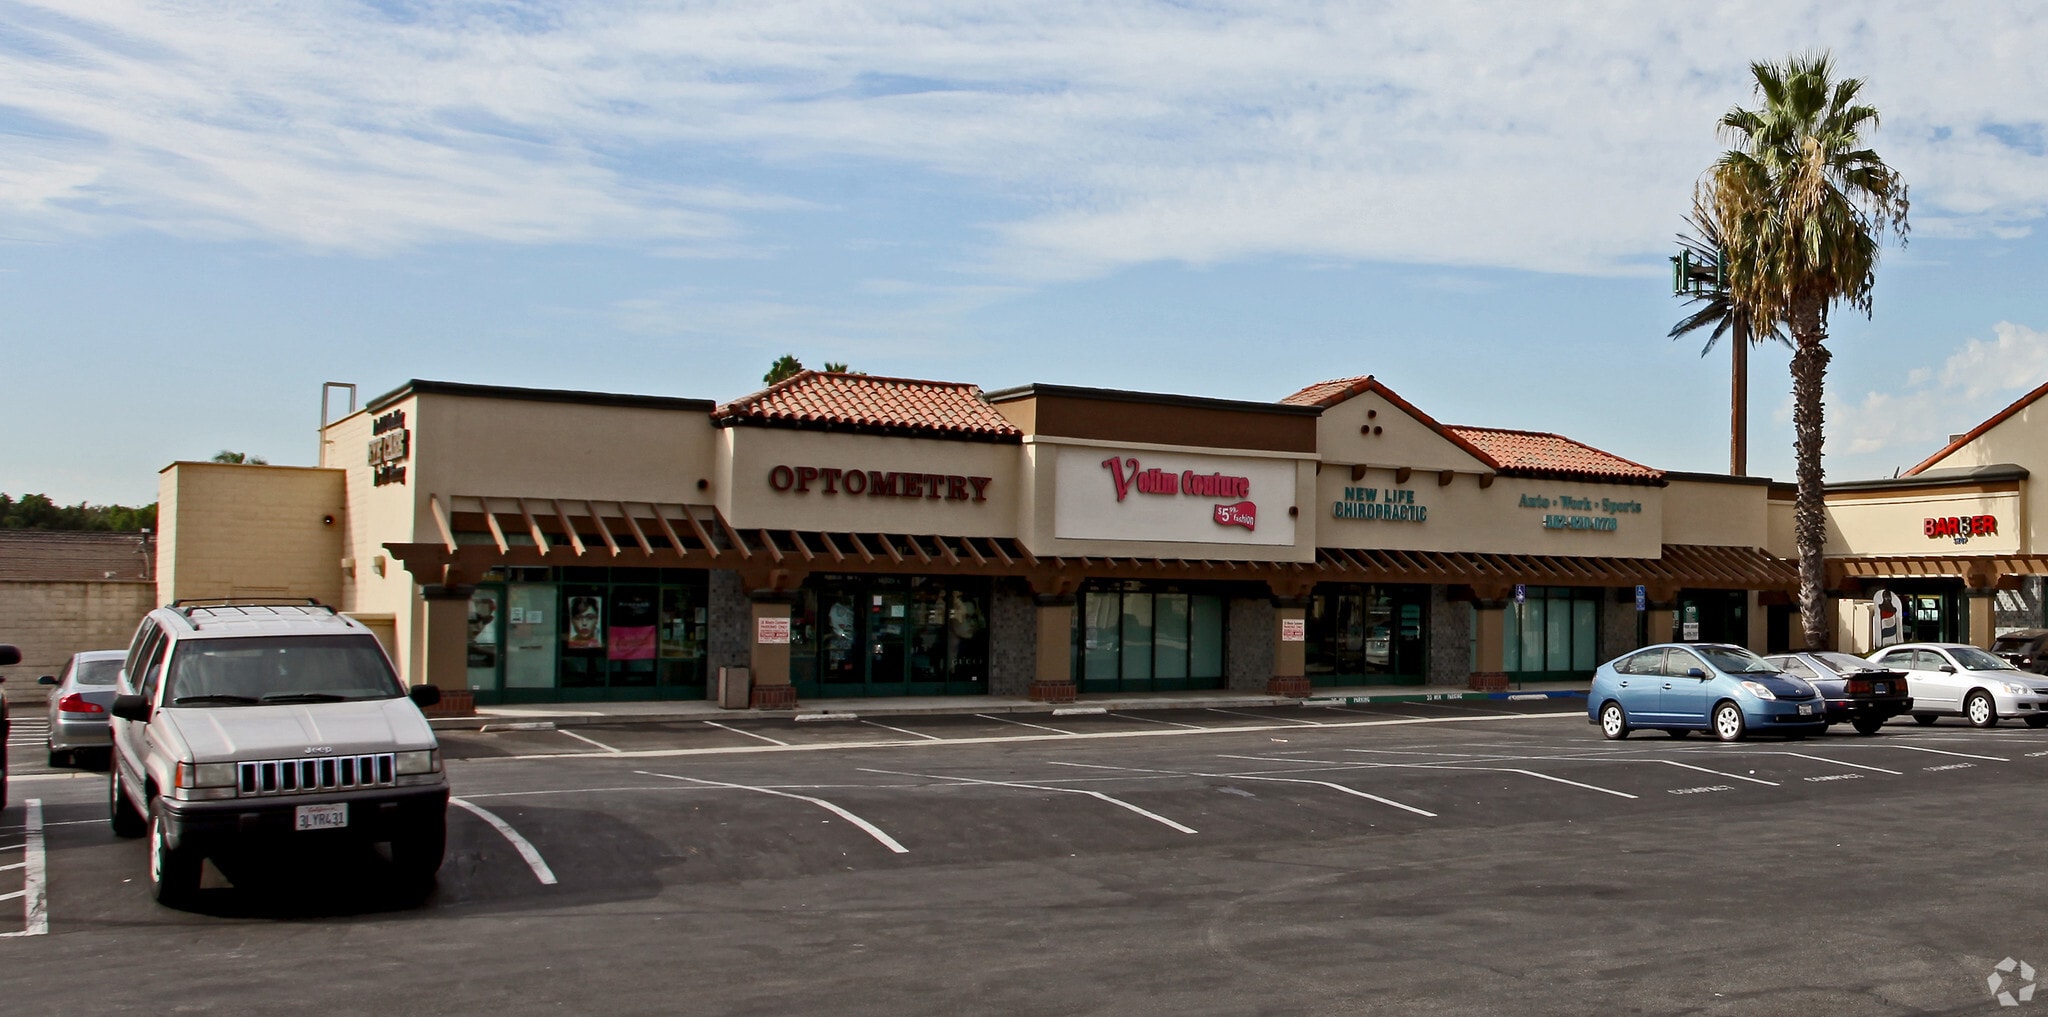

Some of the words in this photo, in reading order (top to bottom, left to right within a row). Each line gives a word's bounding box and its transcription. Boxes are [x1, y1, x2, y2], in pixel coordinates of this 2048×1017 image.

[769, 465, 992, 501] OPTOMETRY
[1182, 470, 1250, 498] Couture
[1345, 487, 1377, 501] NEW
[1384, 489, 1414, 504] LIFE
[1519, 494, 1550, 508] Auto
[1559, 496, 1592, 511] Work
[1602, 498, 1642, 514] Sports
[1233, 513, 1254, 525] fashion
[1331, 501, 1427, 521] CHIROPRACTIC
[1924, 515, 1997, 537] BARBER
[304, 746, 333, 754] Jeep
[299, 812, 344, 827] 3LYR431
